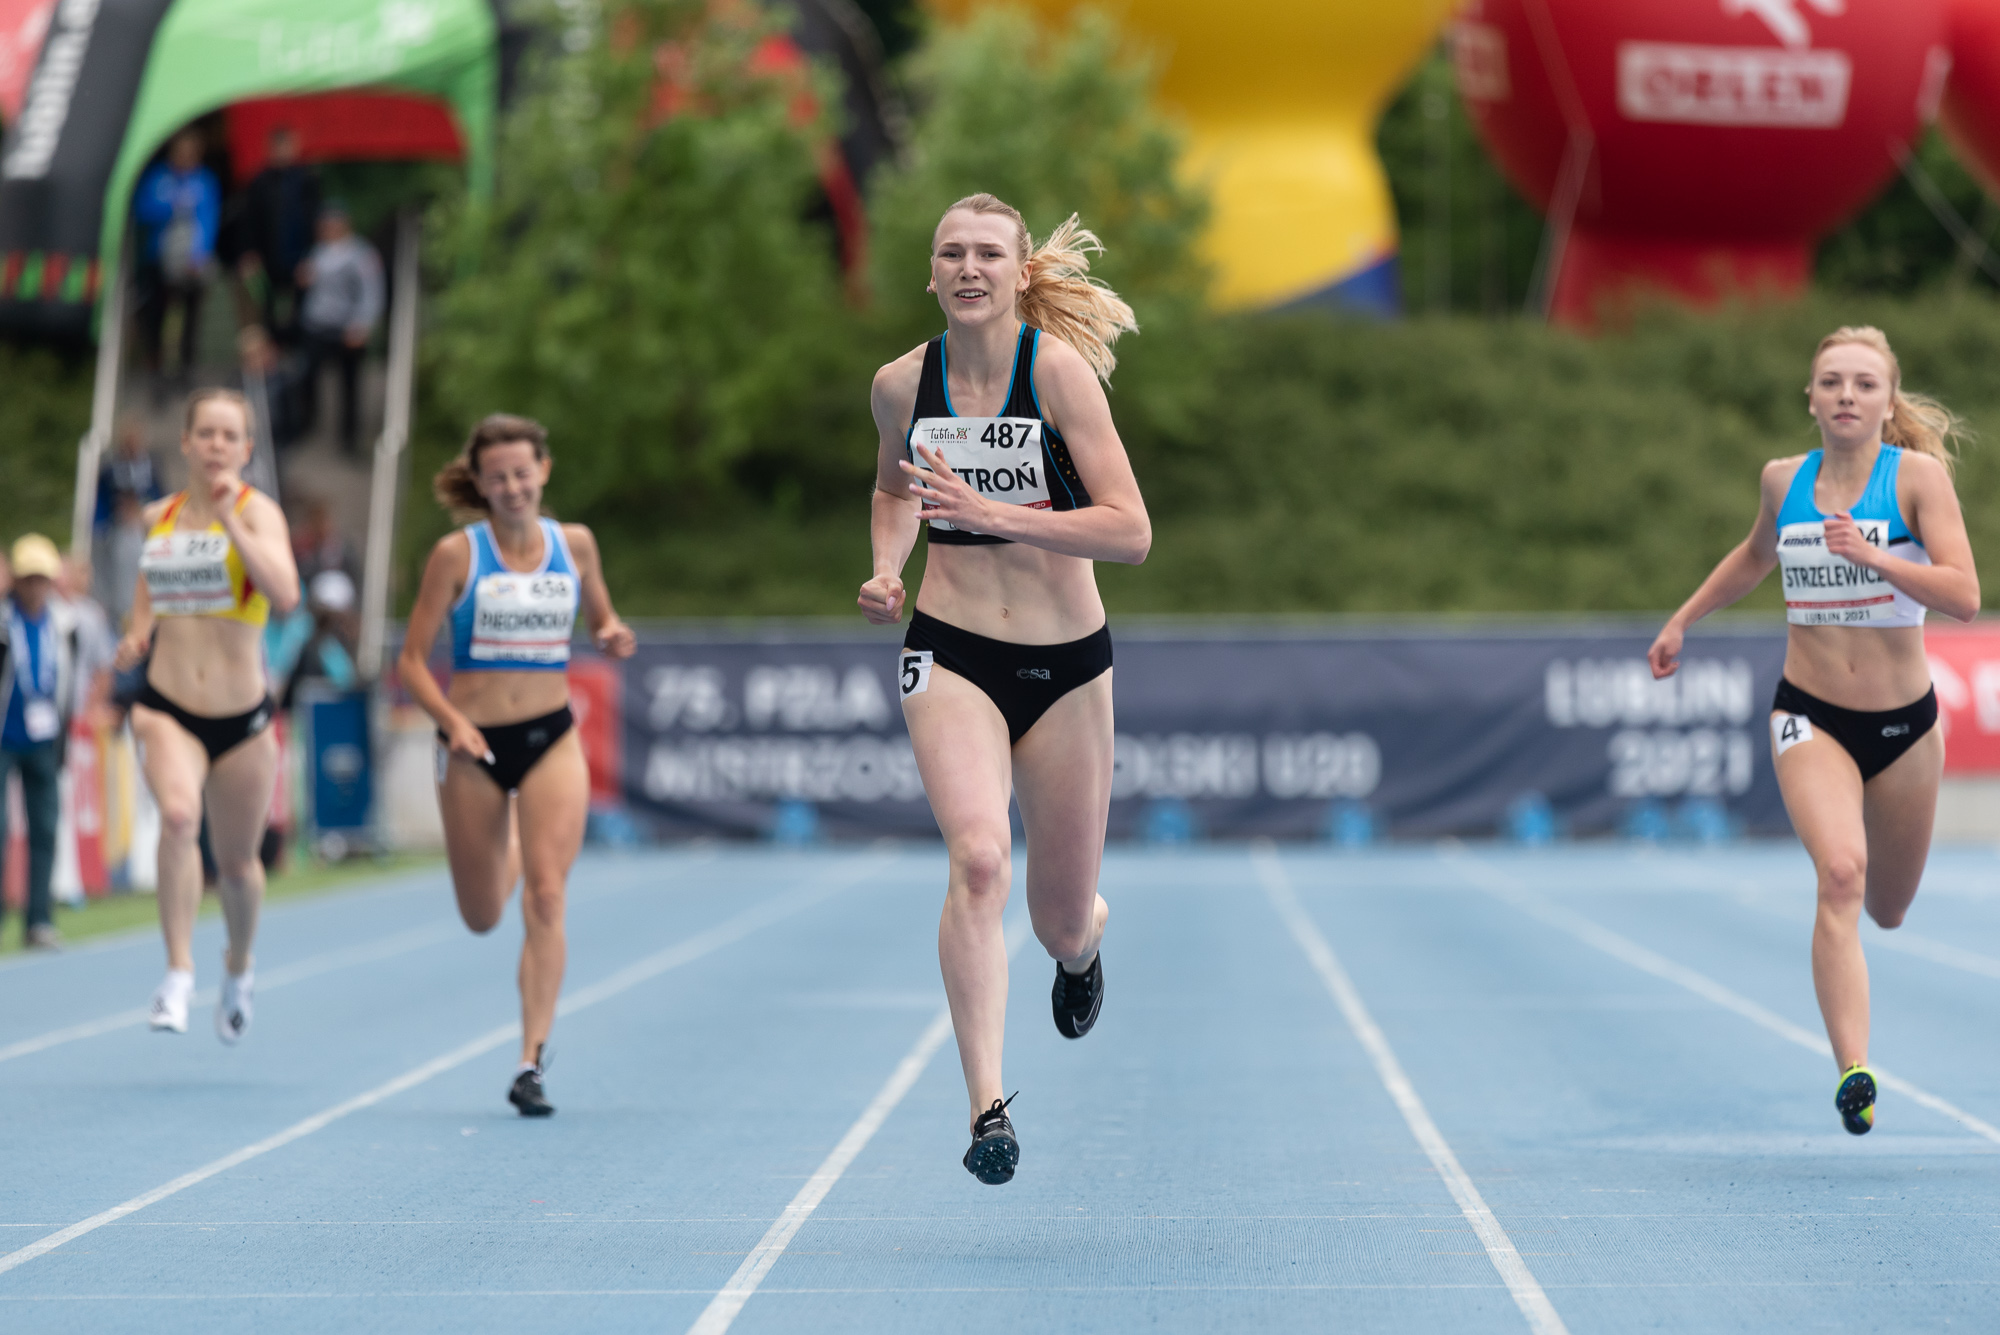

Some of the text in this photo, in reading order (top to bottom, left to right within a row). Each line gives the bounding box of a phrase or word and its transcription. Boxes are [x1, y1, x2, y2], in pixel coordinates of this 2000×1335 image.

[980, 423, 1033, 449] 487
[1804, 610, 1871, 624] LUBLIN 2021
[902, 656, 922, 694] 5
[1017, 668, 1051, 680] esa
[744, 664, 890, 731] PZLA
[1546, 660, 1752, 727] LUBLIN
[1781, 717, 1802, 742] 4
[1608, 732, 1752, 796] 2021
